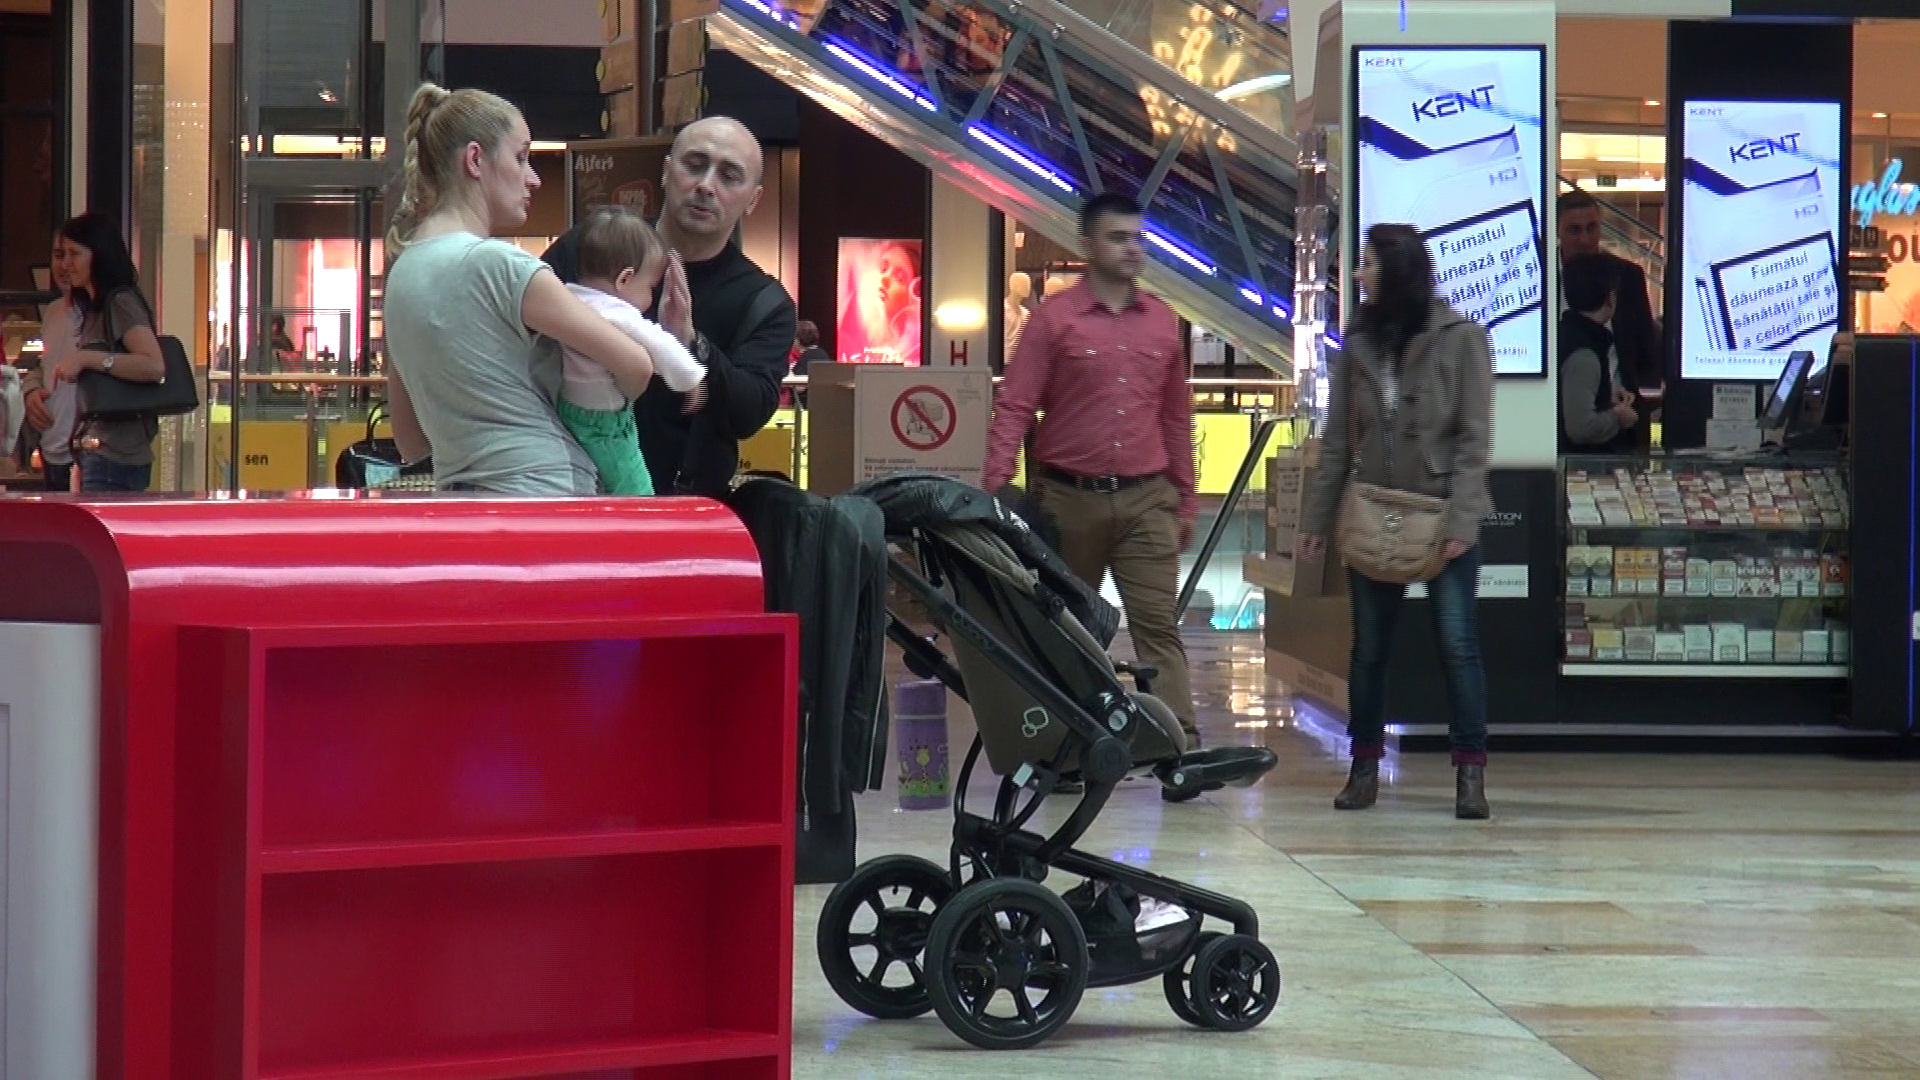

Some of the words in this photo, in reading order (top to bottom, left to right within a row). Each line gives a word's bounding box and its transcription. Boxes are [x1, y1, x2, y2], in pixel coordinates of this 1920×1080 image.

[1365, 58, 1404, 66] KENT
[1412, 84, 1495, 122] KENT
[1690, 108, 1724, 116] KENT
[1729, 132, 1801, 164] KENT
[1489, 167, 1517, 185] HD
[1795, 204, 1819, 219] HD
[1439, 223, 1506, 257] Fumatul
[1437, 252, 1495, 283] unează
[1500, 239, 1530, 266] grav
[1751, 251, 1808, 280] Fumatul
[1494, 267, 1520, 287] tale
[1465, 306, 1487, 323] lor
[1491, 292, 1515, 312] din
[1518, 284, 1538, 305] jur
[1731, 277, 1798, 308] dăunează
[1798, 289, 1820, 306] tale
[1744, 337, 1751, 349] a
[1756, 322, 1790, 343] celor
[1794, 311, 1815, 327] din
[1818, 303, 1836, 322] jur
[951, 340, 967, 365] H
[245, 455, 269, 466] sen
